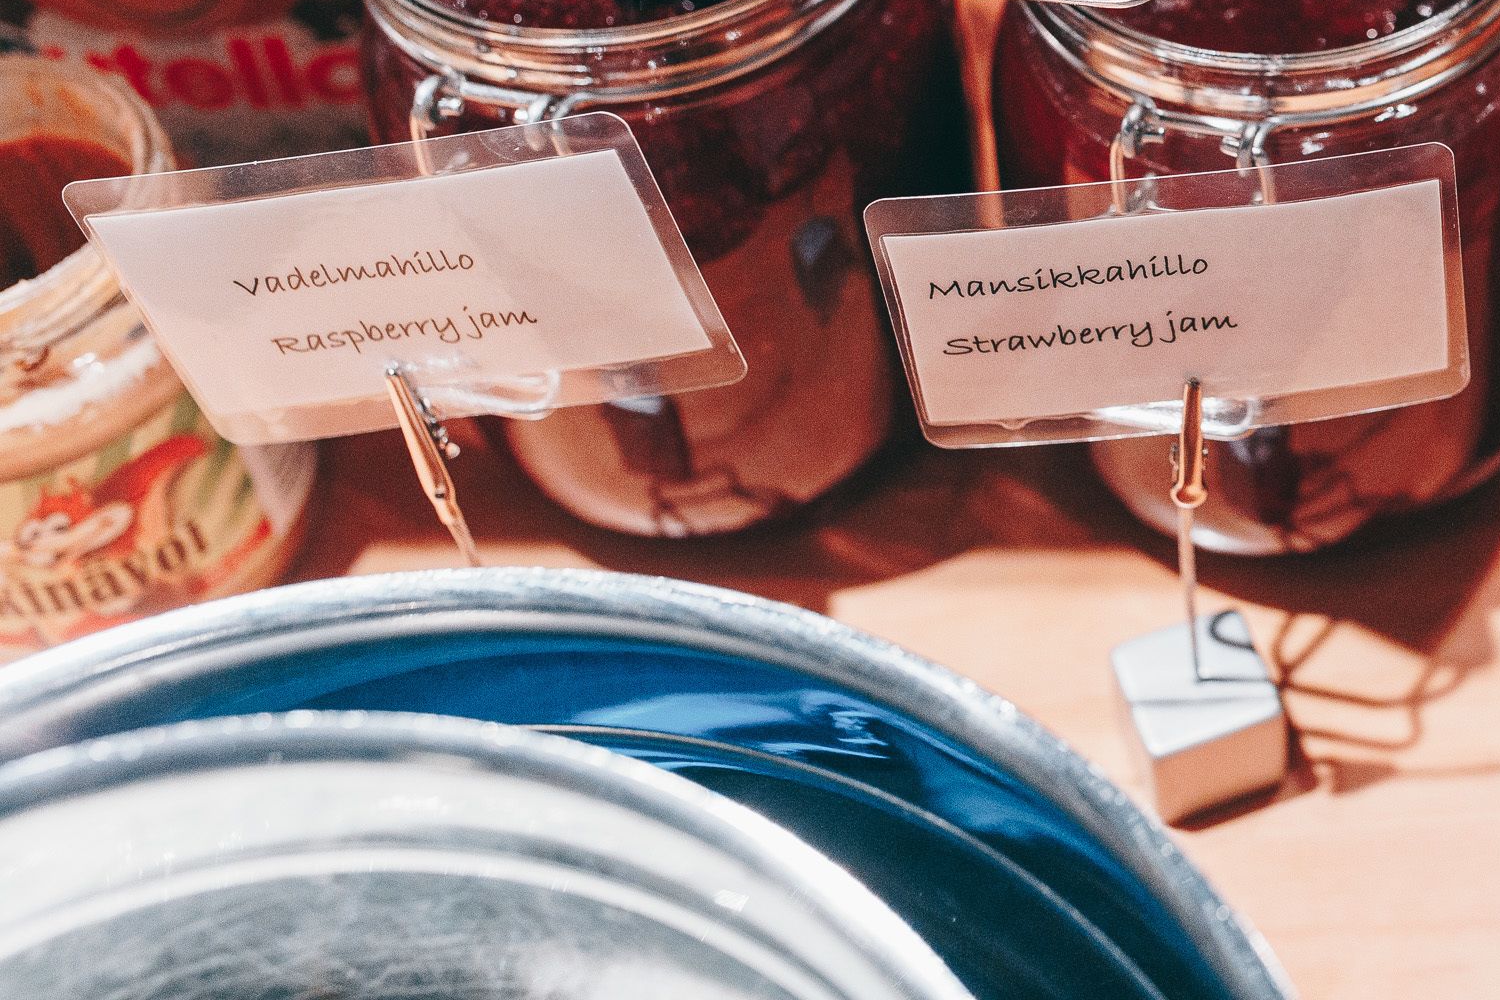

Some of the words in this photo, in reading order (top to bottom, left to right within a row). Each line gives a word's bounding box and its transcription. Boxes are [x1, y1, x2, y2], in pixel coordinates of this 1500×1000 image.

[233, 249, 474, 296] Vadelmahillo
[929, 254, 1209, 300] Mansikkahillo
[271, 316, 461, 354] Raspberry
[465, 305, 538, 339] jam
[943, 320, 1154, 356] Strawberry
[1159, 310, 1238, 343] jam
